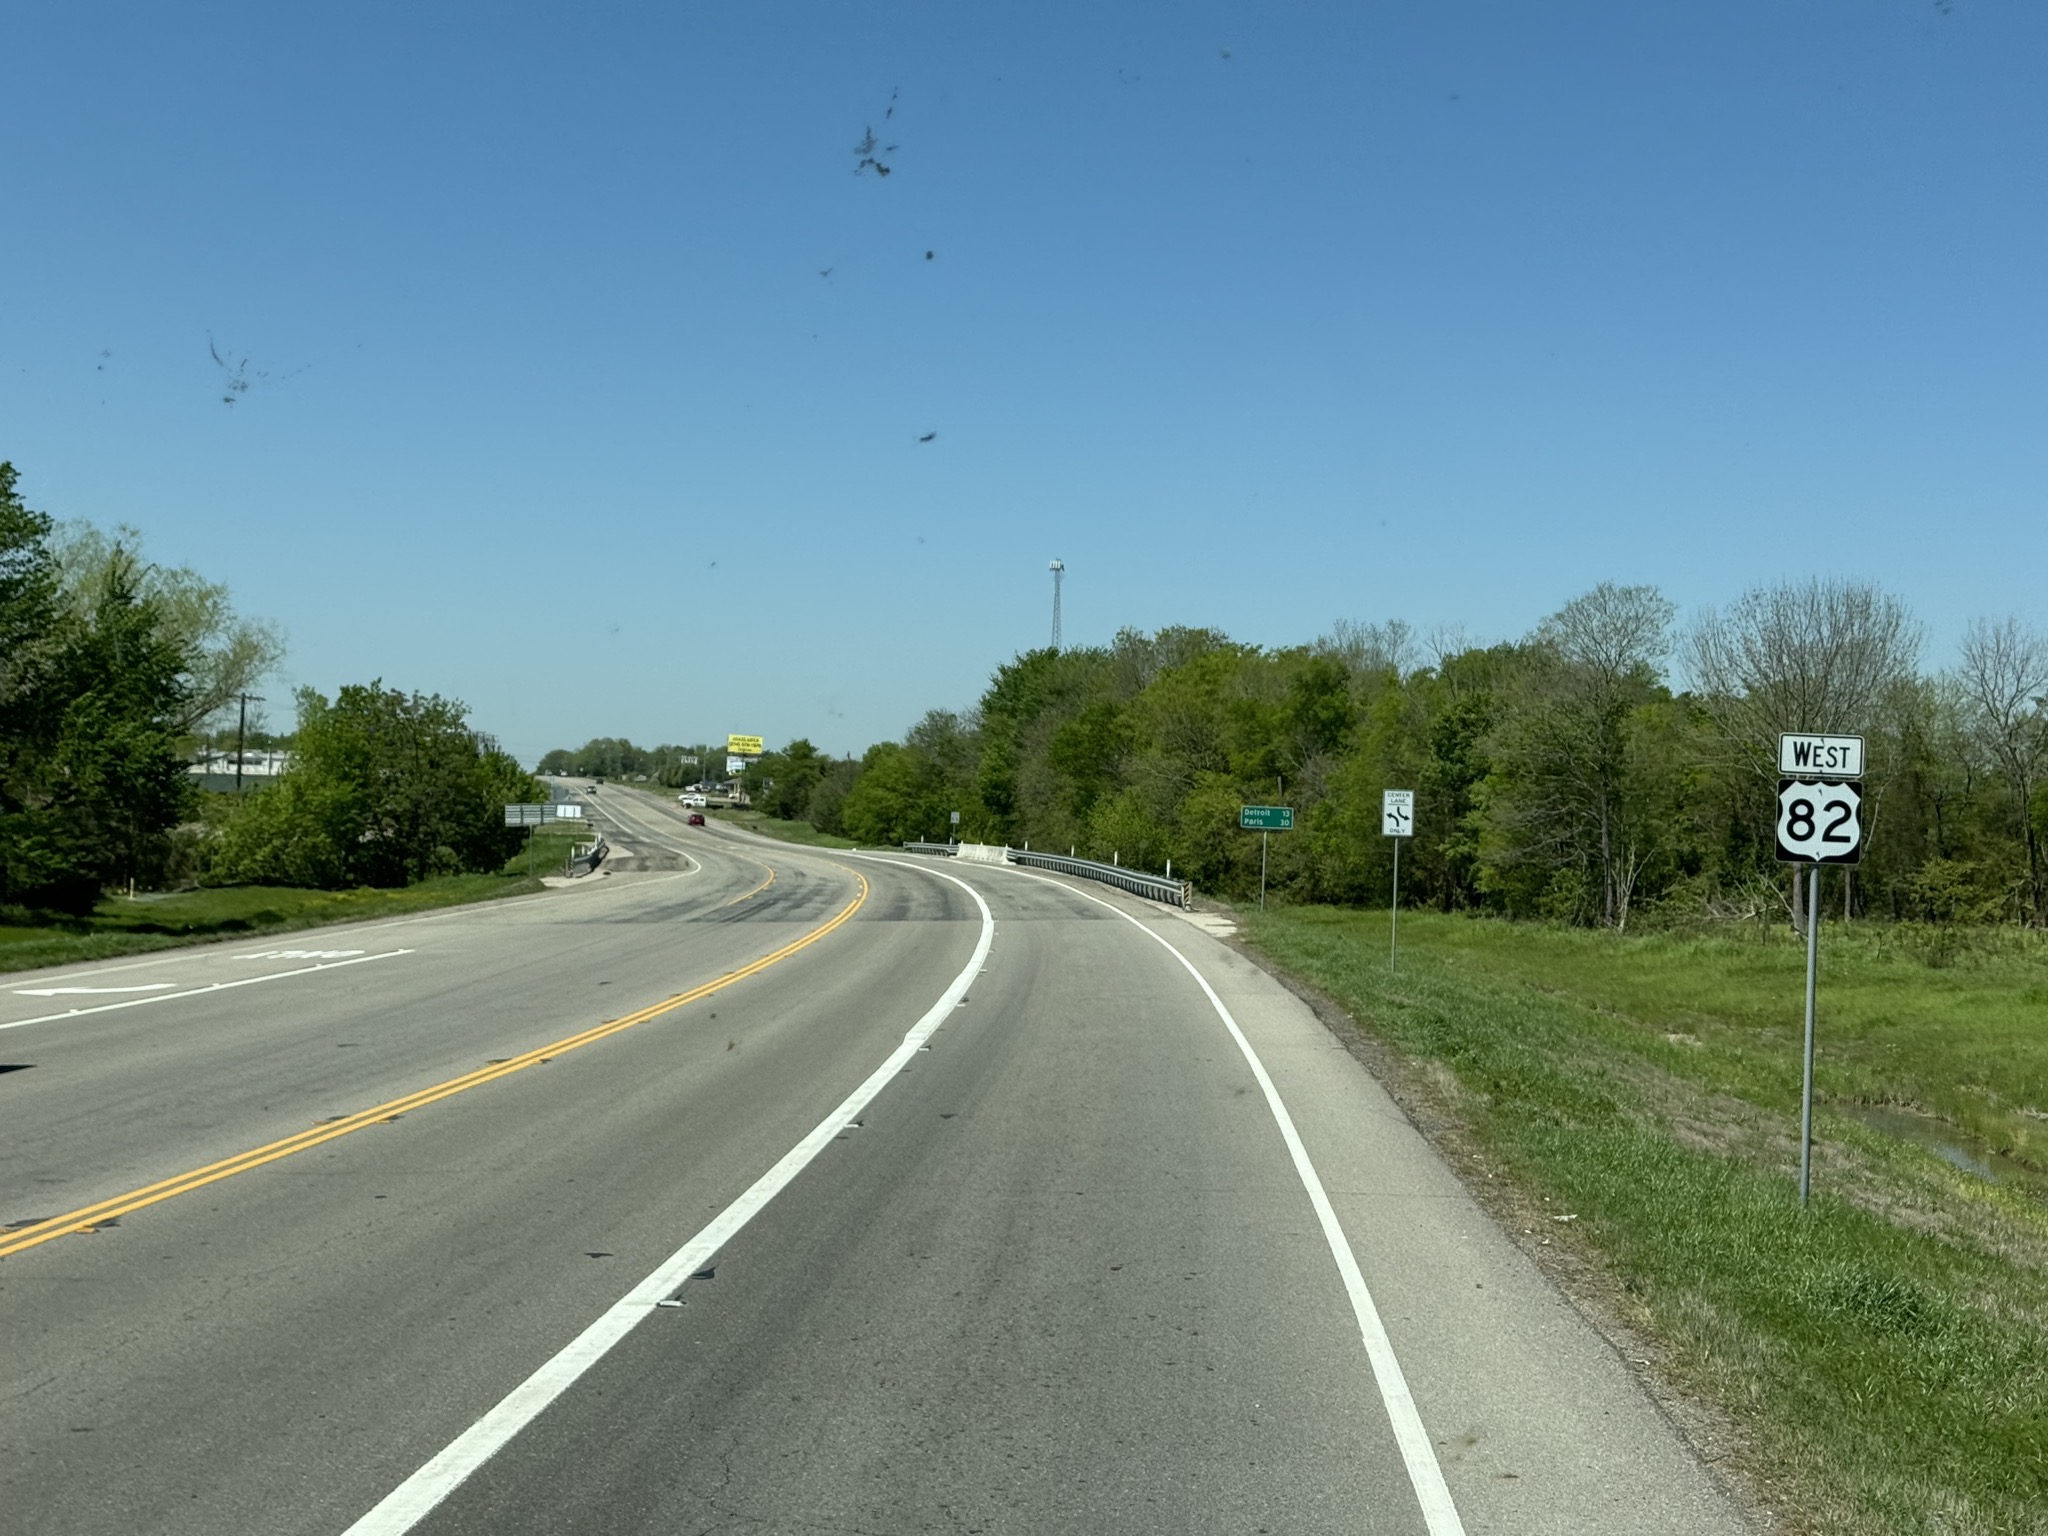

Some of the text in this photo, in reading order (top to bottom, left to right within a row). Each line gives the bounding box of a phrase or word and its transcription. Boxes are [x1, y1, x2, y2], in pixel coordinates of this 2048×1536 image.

[1793, 741, 1851, 768] WEST
[1244, 808, 1271, 817] Detroit
[1786, 798, 1852, 843] 82
